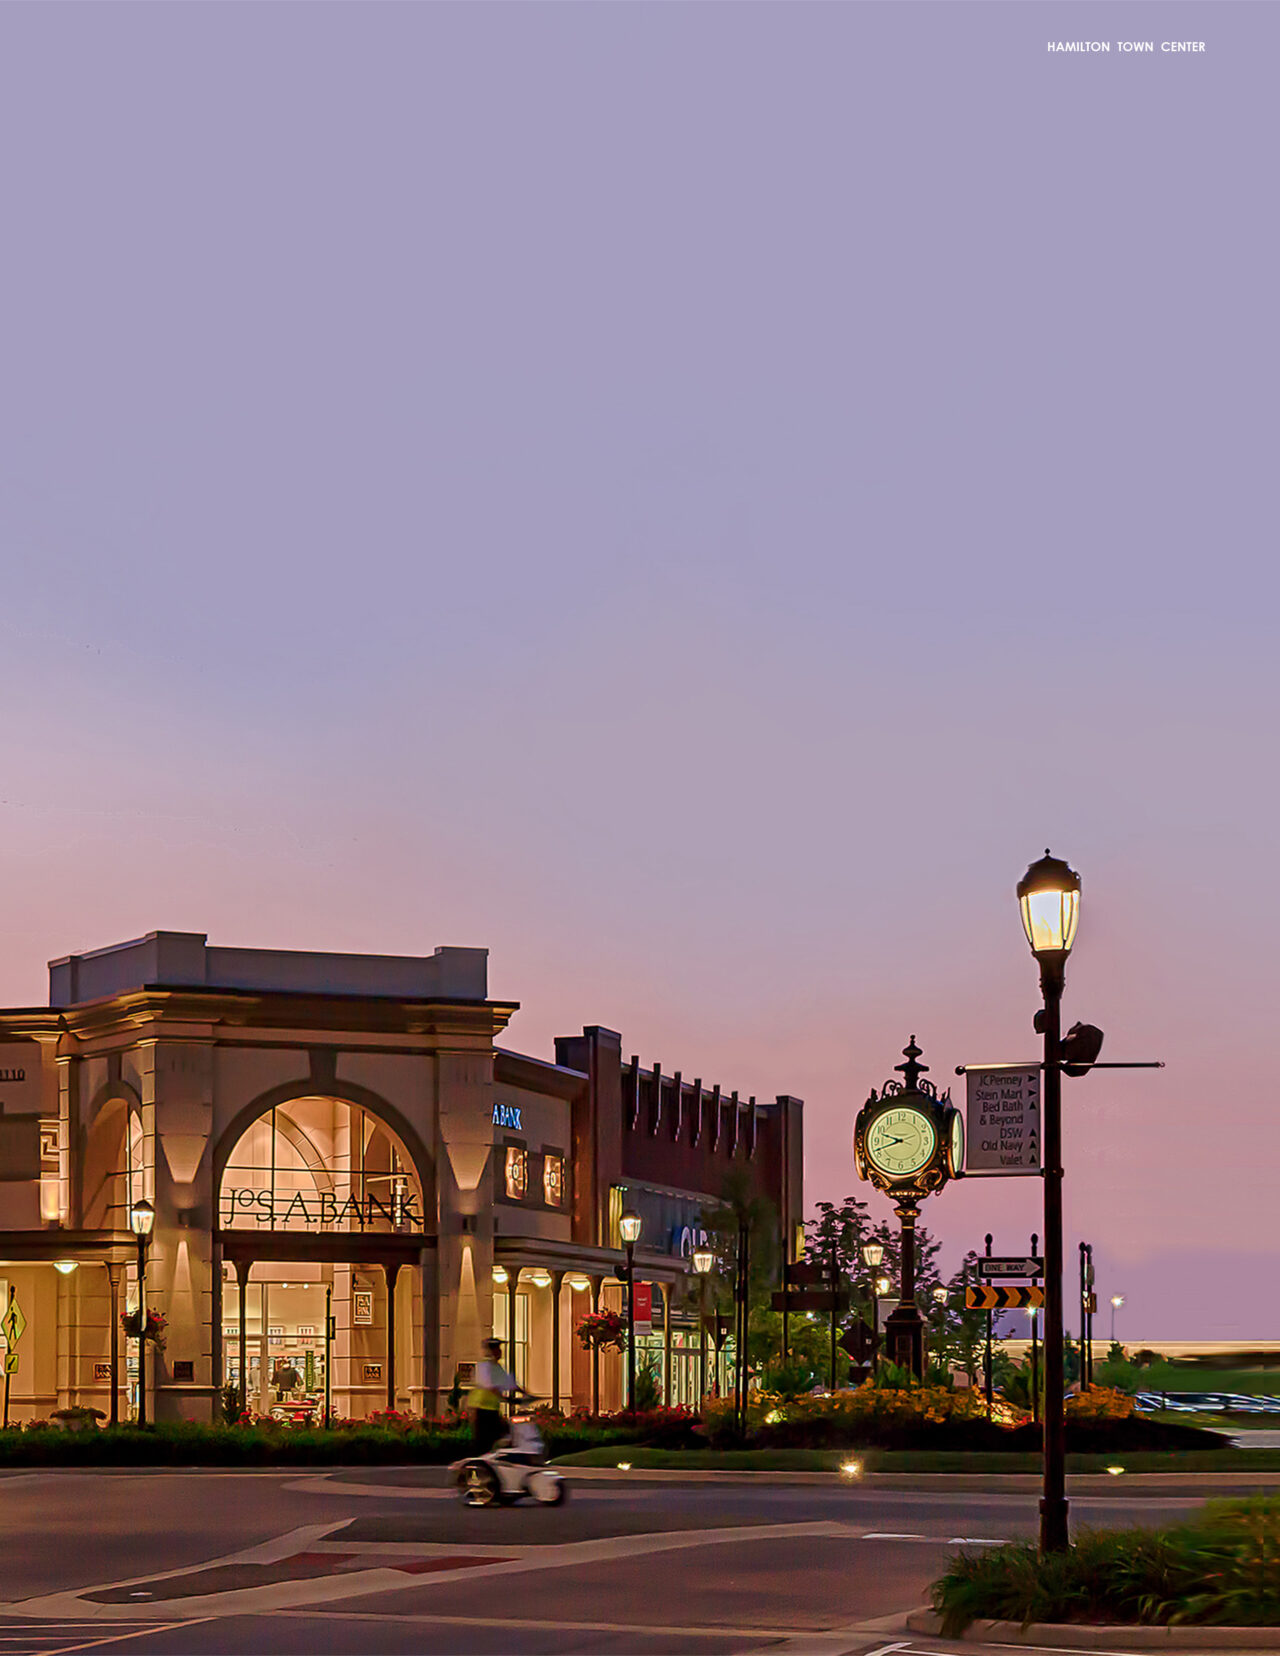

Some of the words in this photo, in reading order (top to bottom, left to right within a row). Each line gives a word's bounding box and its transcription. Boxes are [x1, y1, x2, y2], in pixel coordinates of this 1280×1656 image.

[976, 1090, 998, 1101] Stein
[1001, 1088, 1022, 1099] Mart
[983, 1101, 1000, 1112] Bed
[1002, 1100, 1023, 1111] Bath
[980, 1115, 987, 1125] &
[989, 1114, 1023, 1126] Beyond
[1000, 1128, 1023, 1138] DSW
[982, 1140, 998, 1151] Old
[1001, 1141, 1023, 1152] Navy
[1000, 1154, 1023, 1165] Valet
[320, 1192, 424, 1226] BANK
[985, 1263, 1003, 1271] ONE
[1006, 1263, 1025, 1271] WAY
